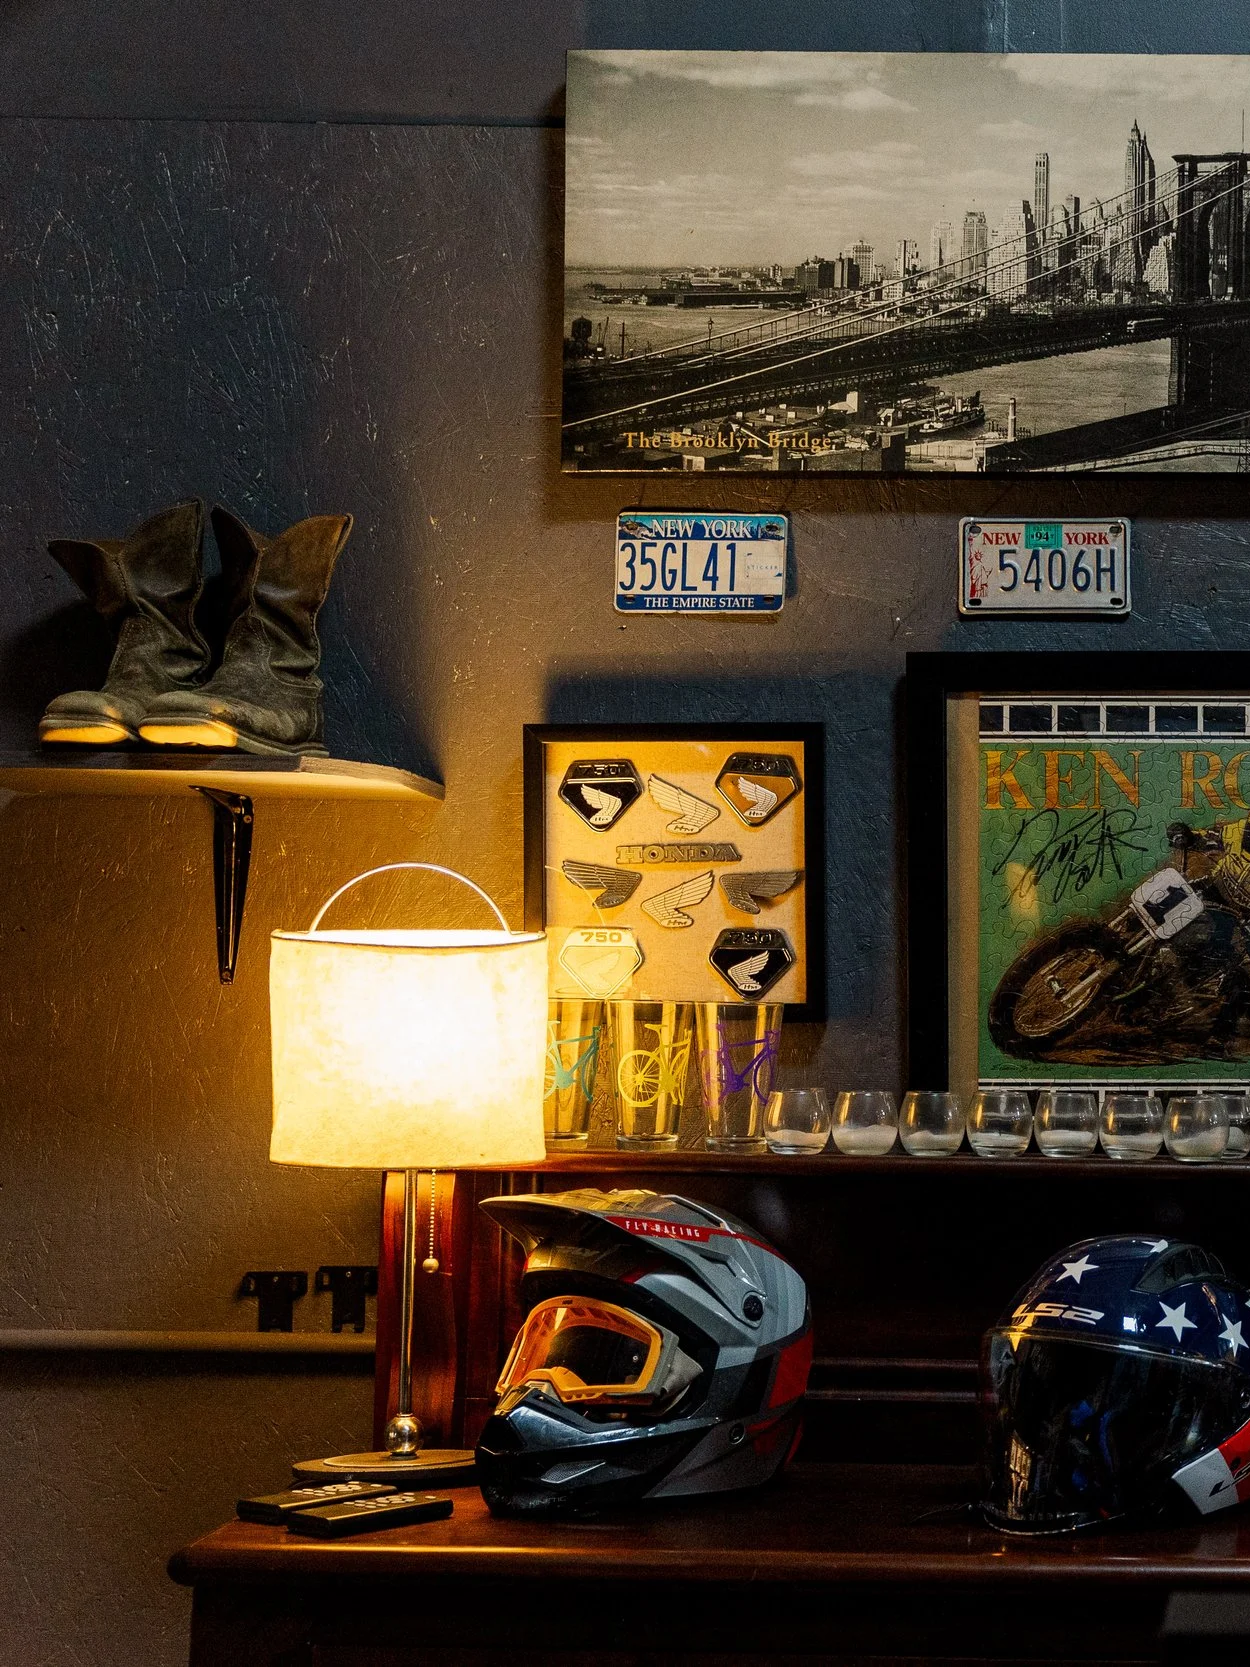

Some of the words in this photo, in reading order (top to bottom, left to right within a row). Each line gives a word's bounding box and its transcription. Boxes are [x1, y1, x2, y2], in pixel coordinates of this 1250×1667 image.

[623, 432, 661, 448] The
[670, 431, 759, 452] Brooklyn
[768, 432, 832, 453] Bridge
[651, 519, 697, 538] NEW
[701, 519, 753, 538] YORK
[982, 532, 1022, 546] NEW
[1064, 532, 1109, 545] YORK
[619, 542, 737, 592] 35GL41
[998, 549, 1116, 592] 5406H
[644, 597, 669, 608] THE
[672, 597, 716, 608] EMPIRE
[719, 597, 755, 608] STATE
[983, 750, 1146, 810] KEN
[616, 843, 742, 864] HONDA
[580, 931, 623, 943] 750
[625, 1220, 648, 1231] FLY
[655, 1223, 700, 1238] RACING
[1011, 1302, 1105, 1325] LS2
